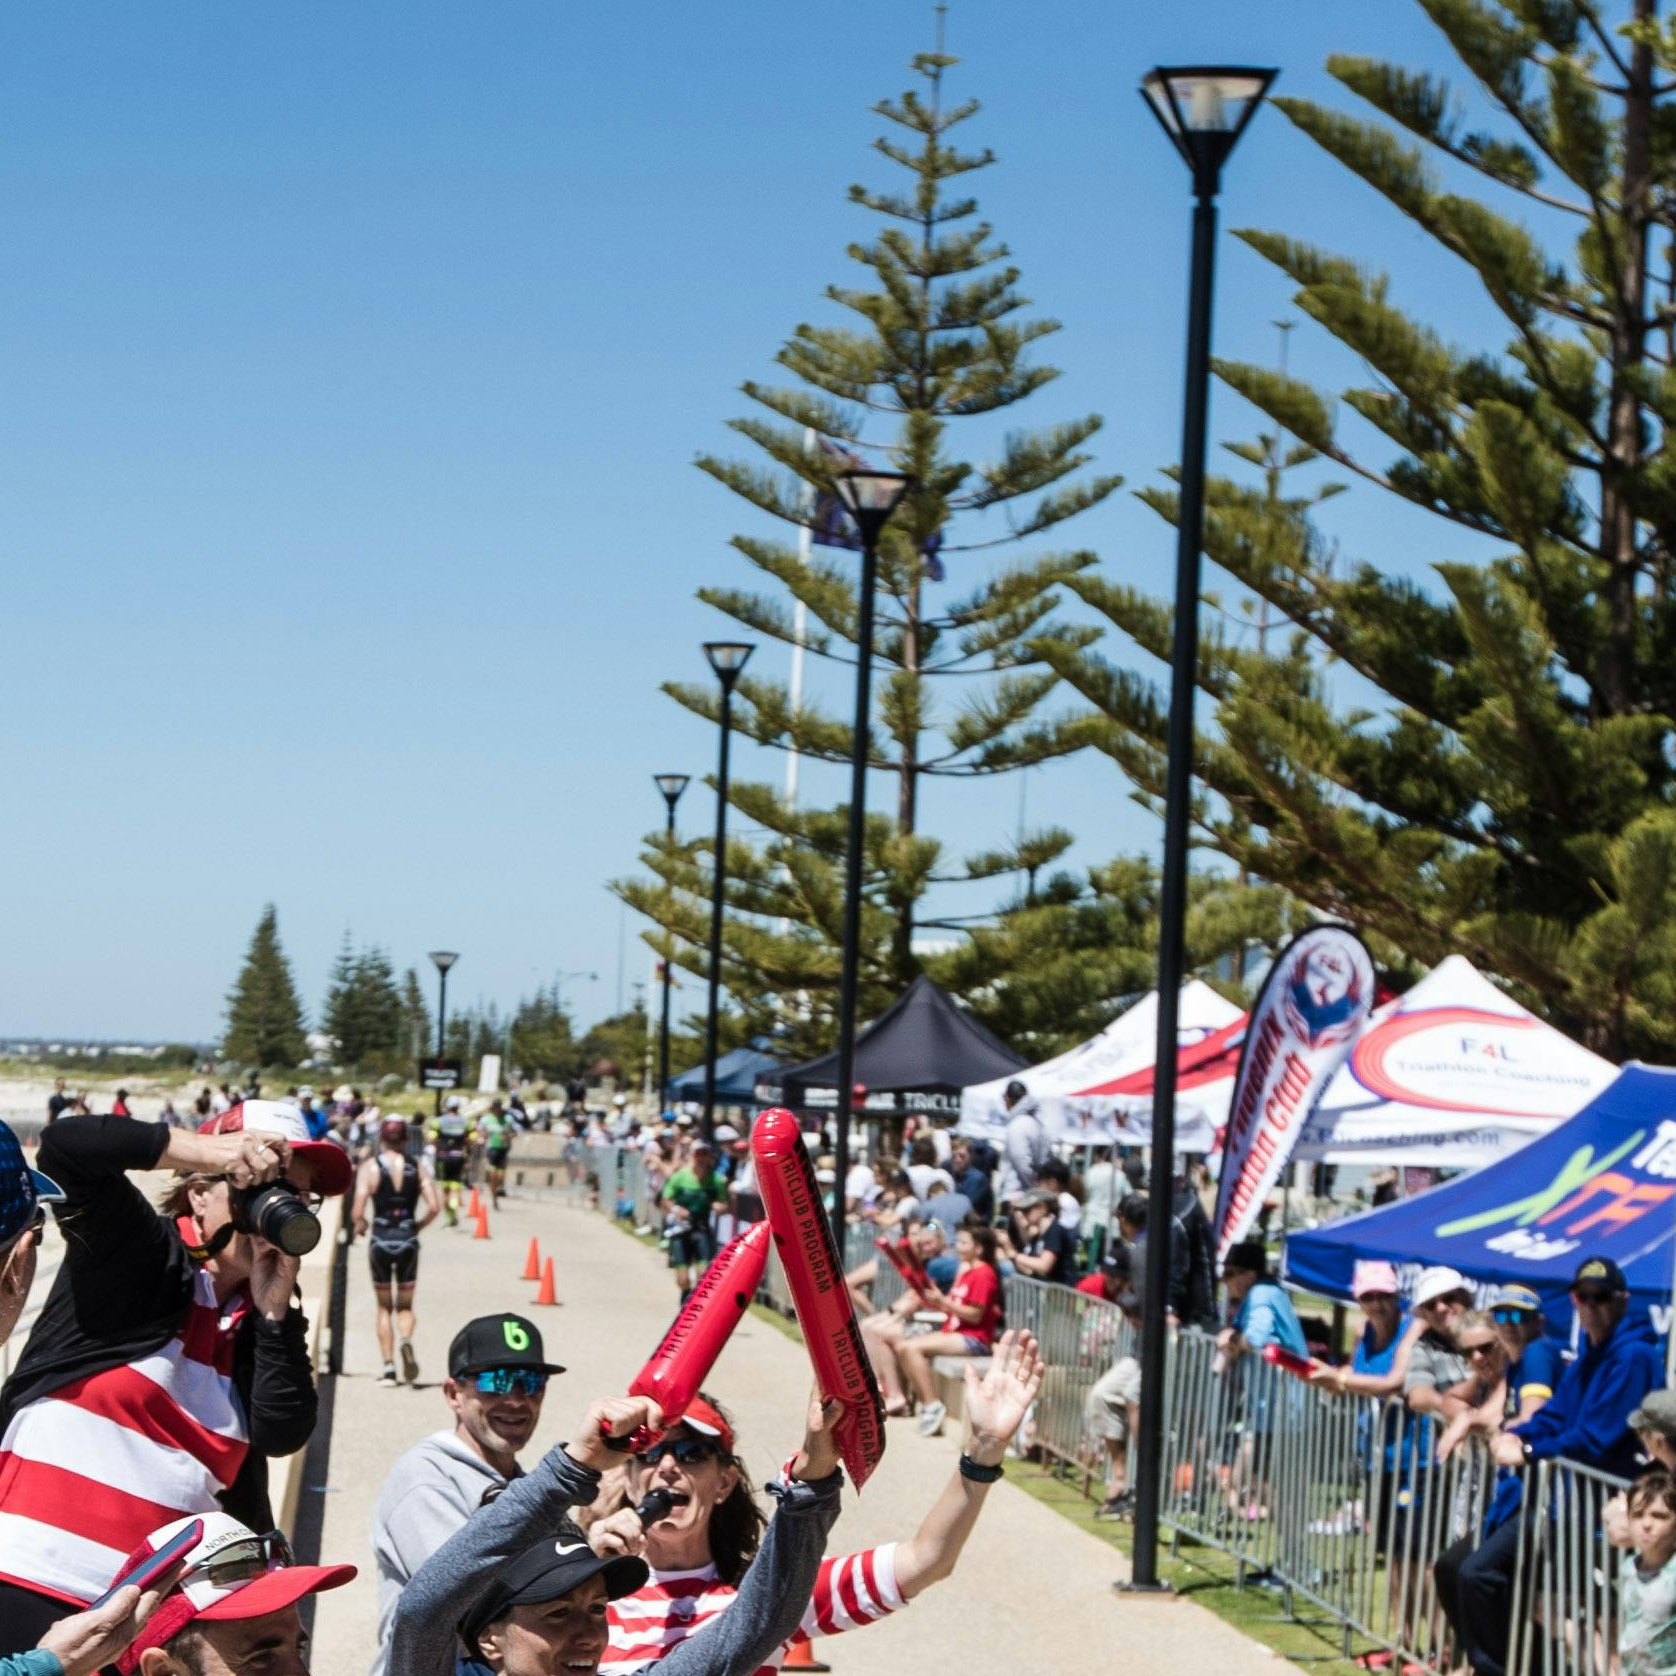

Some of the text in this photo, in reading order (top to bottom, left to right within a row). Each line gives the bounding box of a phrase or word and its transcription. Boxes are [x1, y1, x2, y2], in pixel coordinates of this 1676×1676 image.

[779, 1152, 832, 1294] TRICLUB PROGRAM
[661, 1303, 704, 1361] TRICLUB
[831, 1327, 861, 1389] TRICLUB
[205, 1530, 239, 1551] NORTH
